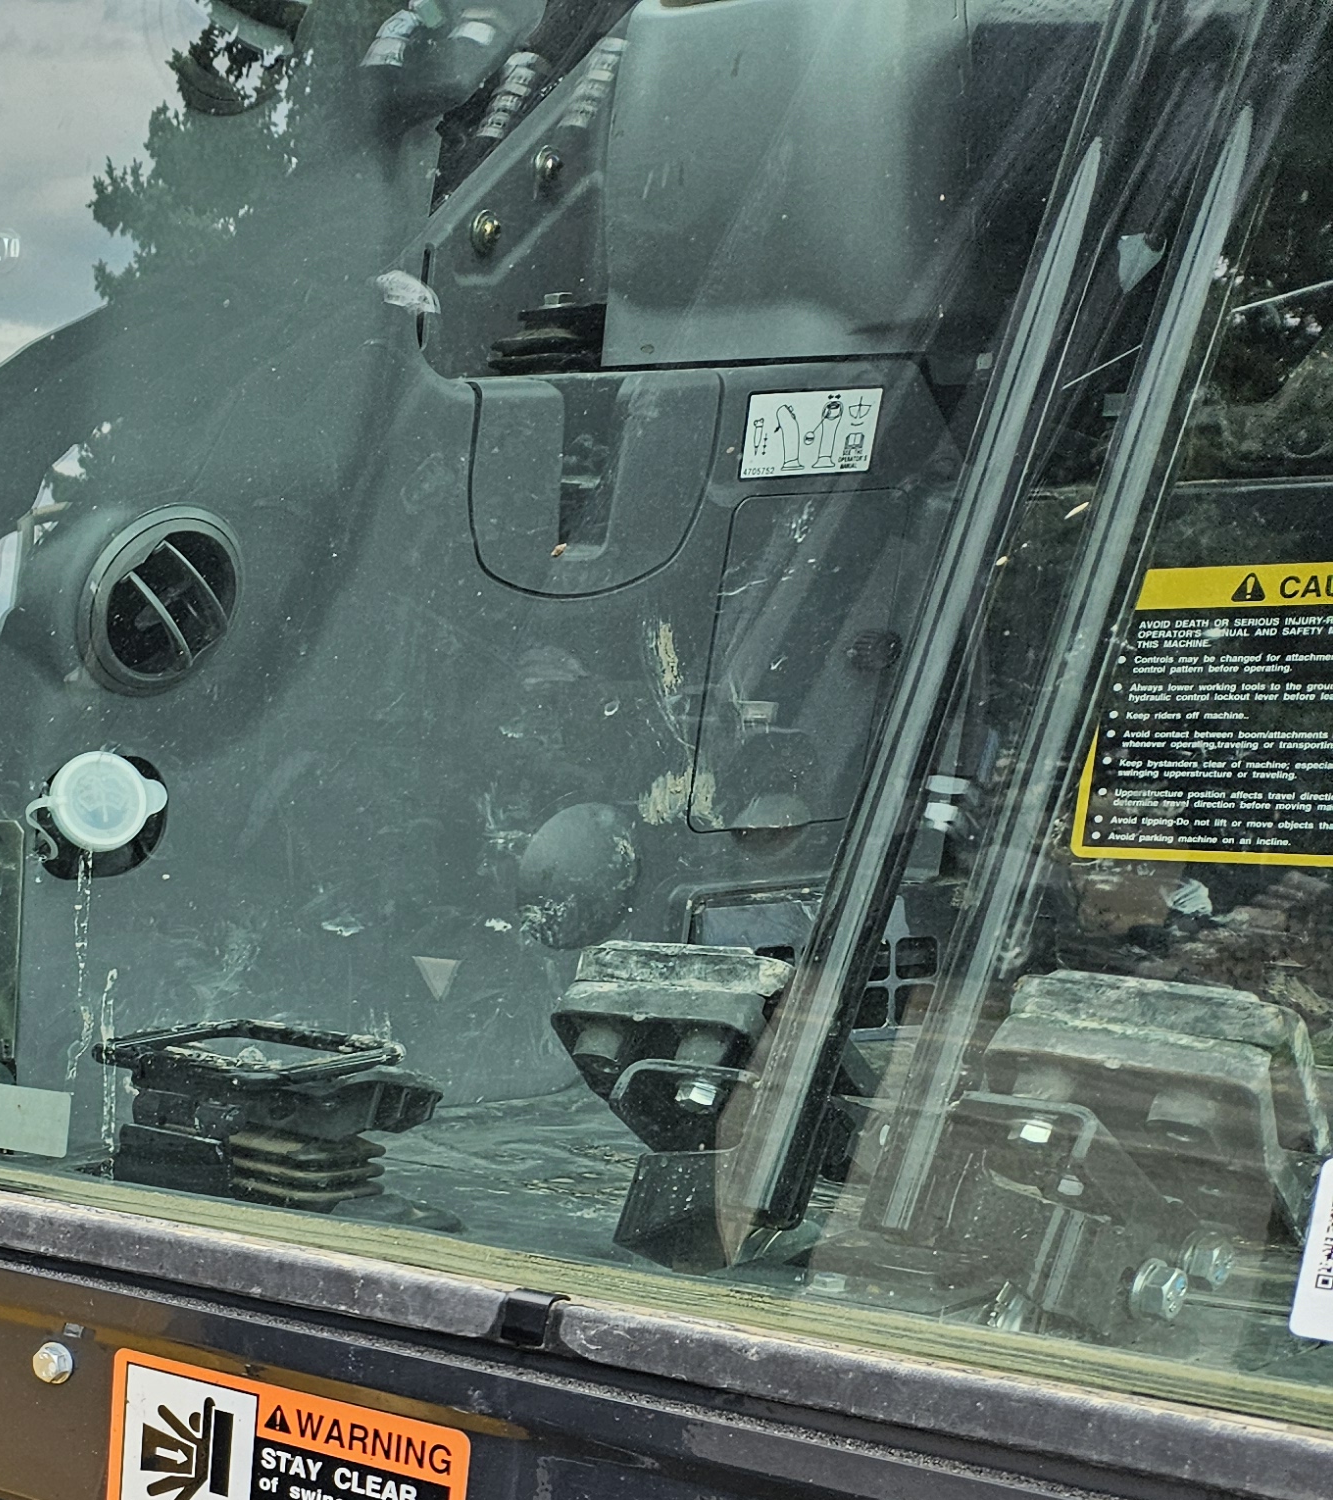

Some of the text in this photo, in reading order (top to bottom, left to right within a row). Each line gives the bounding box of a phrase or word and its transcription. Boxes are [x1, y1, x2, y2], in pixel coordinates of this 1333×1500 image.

[743, 467, 775, 476] 4705752
[1139, 621, 1171, 629] AVOID
[1175, 619, 1209, 628] DEATH
[1214, 618, 1229, 628] OR
[1234, 617, 1279, 627] SERIOUS
[1138, 629, 1201, 638] OPERATOR'S
[1254, 628, 1278, 637] AND
[1282, 627, 1323, 636] SAFETY
[1137, 640, 1159, 648] THIS
[1134, 655, 1174, 664] Controls
[1178, 656, 1199, 665] may
[1203, 655, 1216, 663] be
[1219, 653, 1262, 665] changed
[1266, 654, 1281, 663] for
[1133, 664, 1292, 675] control pattern before operating.
[1129, 683, 1163, 693] Always
[1167, 683, 1194, 692] lower
[1198, 683, 1237, 693] working
[1241, 682, 1266, 692] tools
[1270, 683, 1281, 692] to
[1285, 682, 1302, 692] the
[1128, 693, 1172, 703] hydraulic
[1175, 693, 1210, 701] control
[1214, 692, 1250, 701] lockout
[1254, 692, 1279, 701] lever
[1283, 692, 1316, 701] before
[1126, 711, 1150, 721] Keep
[1154, 711, 1181, 720] riders
[1186, 710, 1200, 720] off
[1123, 730, 1329, 739] Avoid contact between boom/attachments
[1122, 740, 1166, 748] whenever
[1263, 741, 1275, 749] or
[1119, 759, 1143, 769] Keep
[1146, 759, 1198, 769] bystanders
[1203, 760, 1226, 769] clear
[1231, 760, 1243, 769] of
[1118, 769, 1297, 781] swinging upperstructure or traveling.
[1114, 788, 1183, 798] Upperstructure
[1187, 790, 1226, 800] position
[1230, 790, 1263, 800] affects
[1268, 791, 1296, 800] travel
[1194, 800, 1235, 809] direction
[1239, 801, 1271, 810] before
[1275, 802, 1312, 812] moving
[1110, 816, 1137, 825] Avoid
[1141, 816, 1190, 827] tipping-Do
[1194, 818, 1210, 827] not
[1214, 818, 1227, 827] lift
[1278, 821, 1314, 831] objects
[1108, 832, 1135, 841] Avoid
[1138, 833, 1174, 844] parking
[1178, 834, 1218, 844] machine
[1239, 837, 1252, 845] an
[1256, 837, 1291, 846] incline.
[295, 1408, 453, 1476] WARNING
[259, 1448, 323, 1482] STAY
[259, 1475, 279, 1493] of
